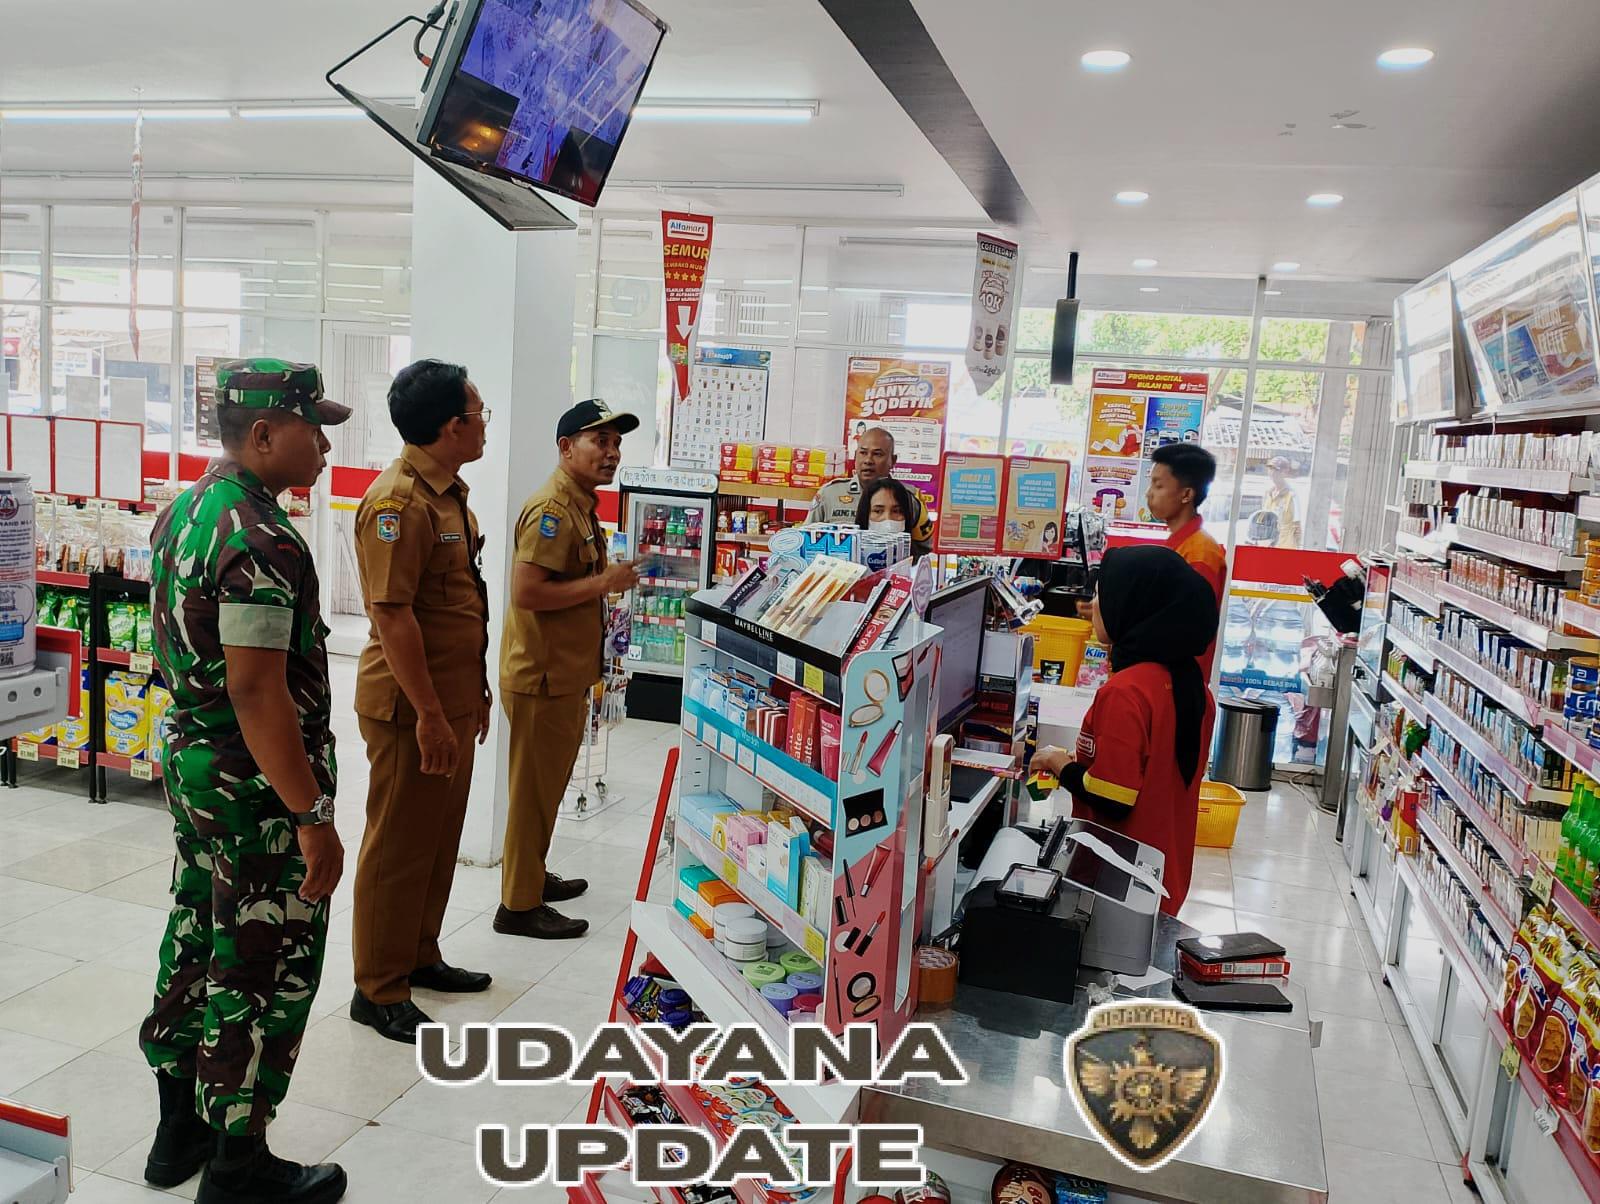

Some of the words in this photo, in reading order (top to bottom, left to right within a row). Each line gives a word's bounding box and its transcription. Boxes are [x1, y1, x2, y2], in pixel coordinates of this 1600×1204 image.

[670, 222, 705, 233] Alfamart
[980, 293, 1001, 310] 10K
[1155, 374, 1183, 382] DIGITAL
[865, 384, 917, 400] HANYA
[860, 398, 888, 418] 30
[888, 397, 936, 409] DETIK
[734, 617, 774, 641] MAYBELLINE
[1263, 679, 1284, 687] BEBAS
